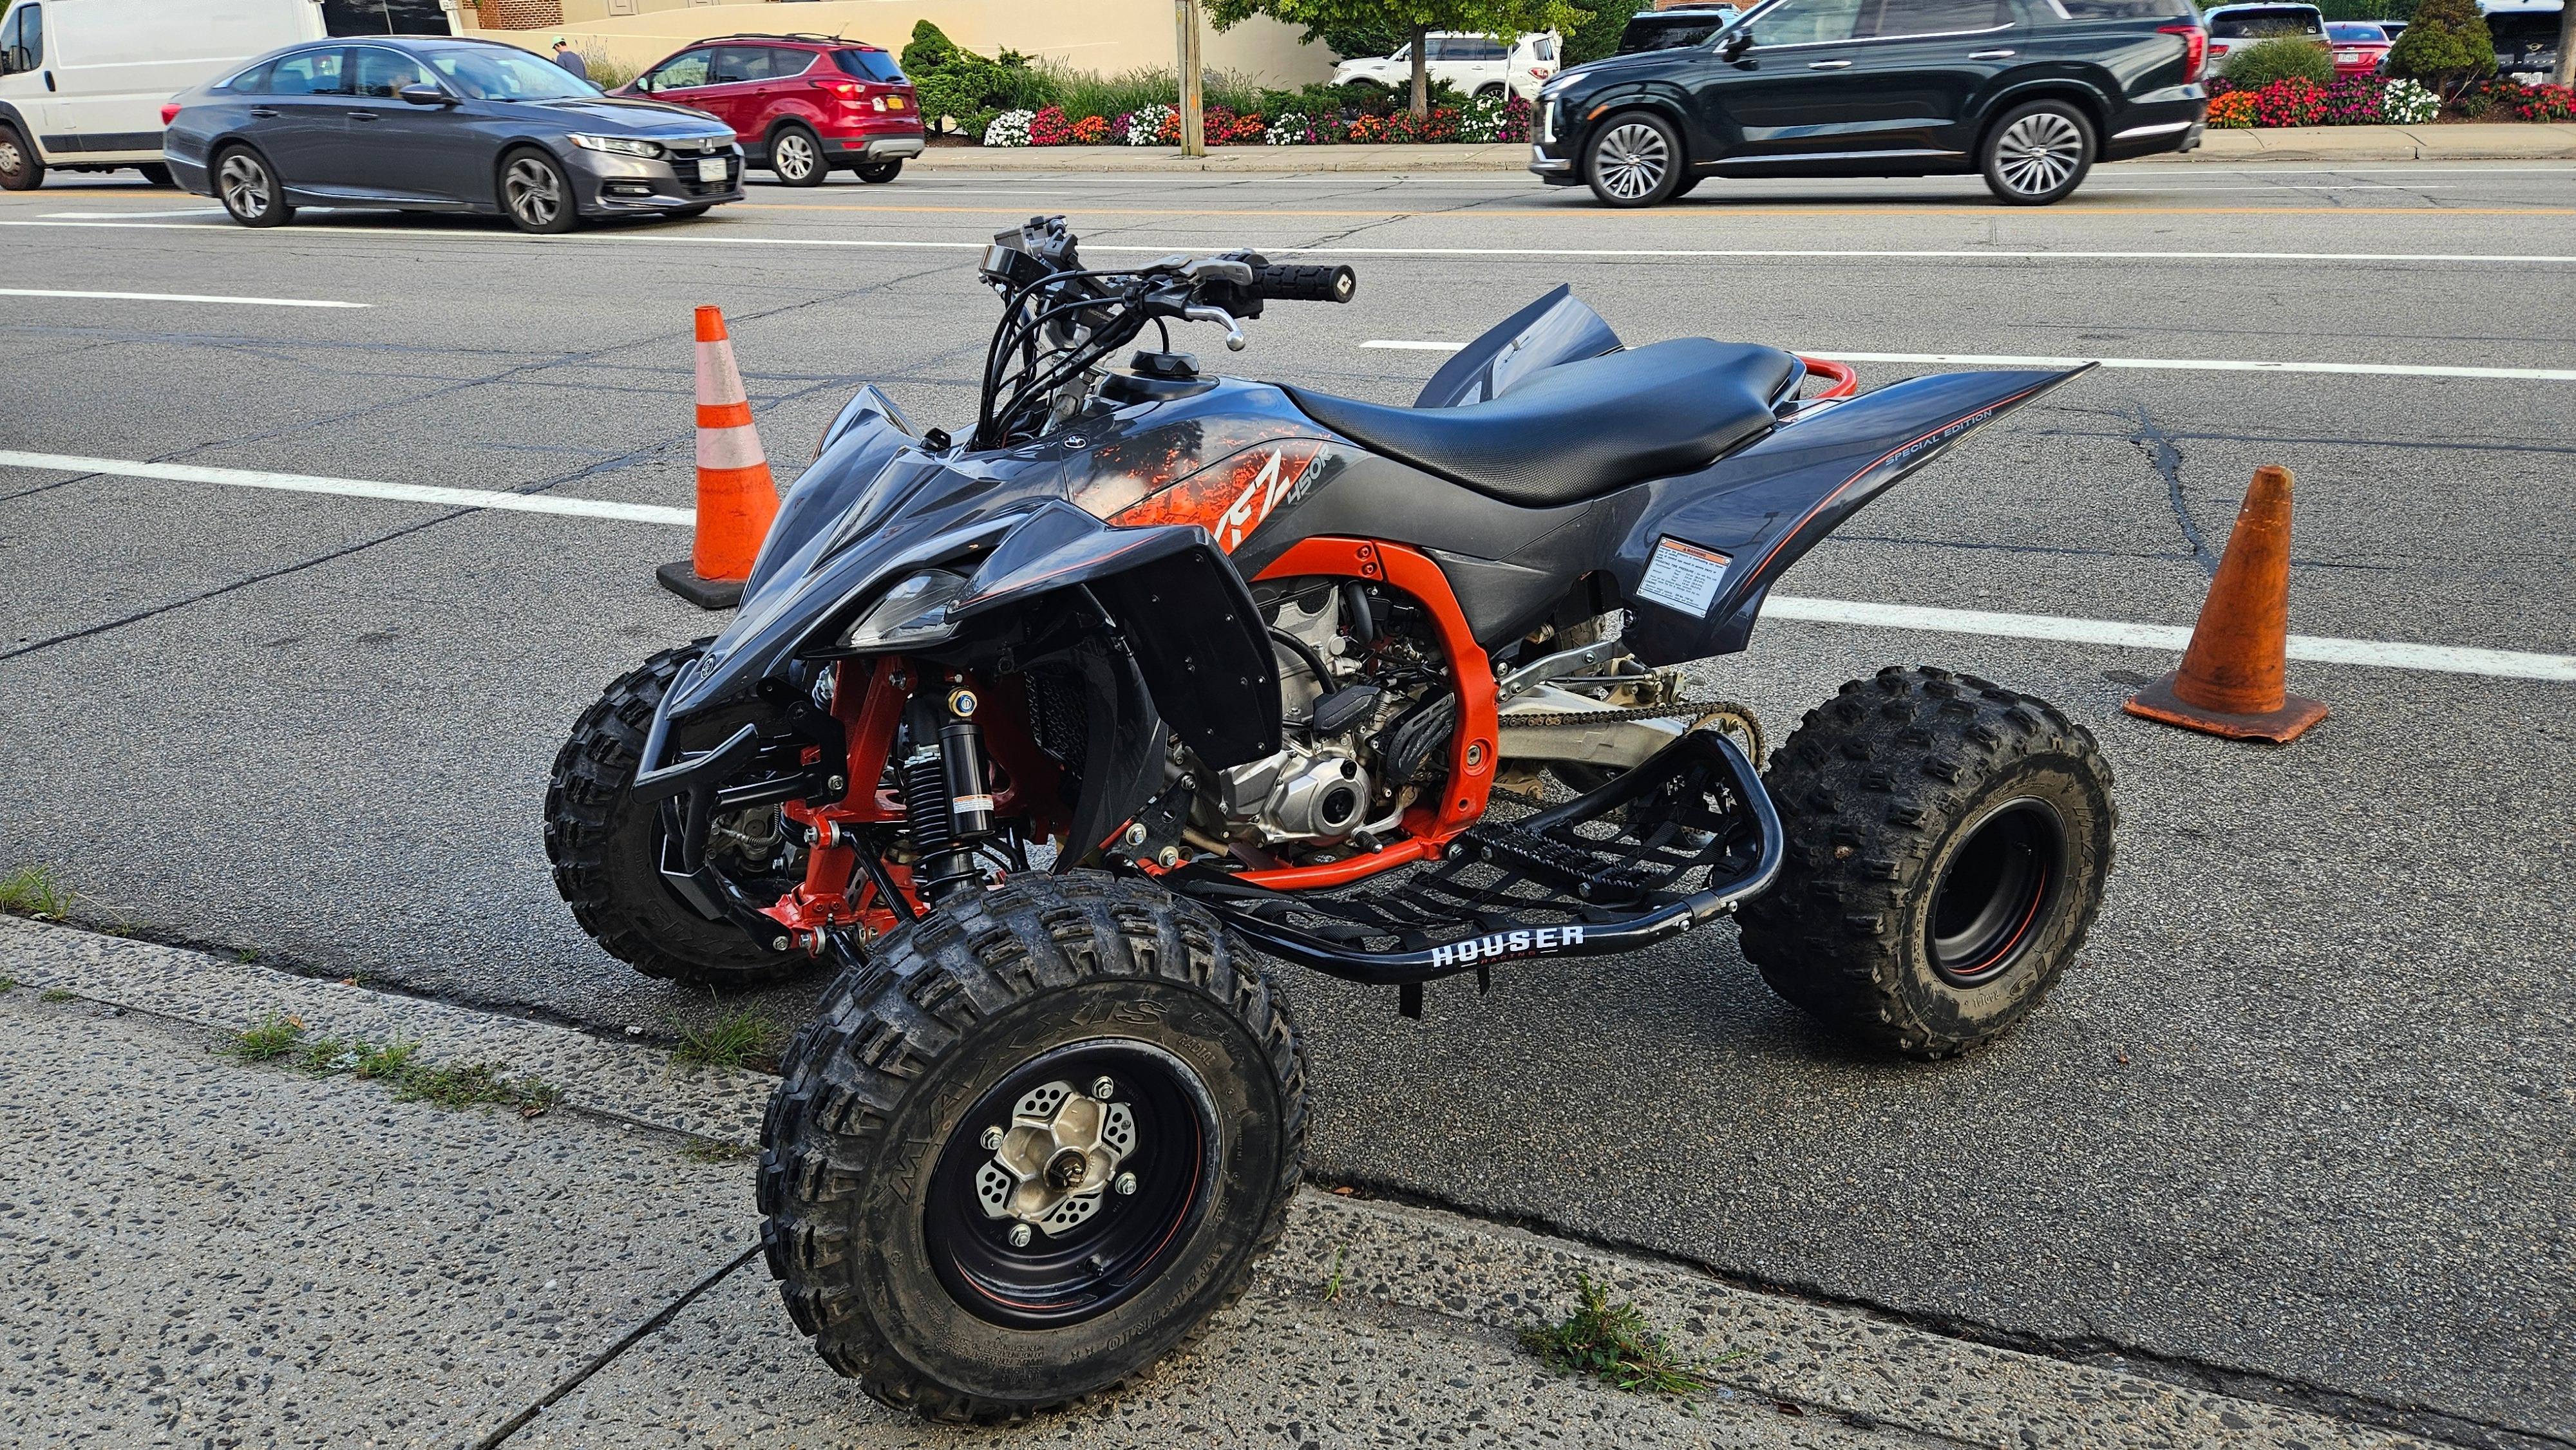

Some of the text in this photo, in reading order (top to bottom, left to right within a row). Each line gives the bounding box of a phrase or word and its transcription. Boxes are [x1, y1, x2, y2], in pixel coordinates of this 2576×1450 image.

[1885, 410, 1992, 466] SPECIAL EDITION
[1287, 443, 1332, 505] 450R
[1686, 548, 1707, 558] WARNING
[2010, 806, 2097, 1002] MAXXIS
[1432, 926, 1585, 968] HOUSER
[1480, 950, 1537, 965] RACING
[1973, 990, 1999, 1008] RADIAL
[1178, 1035, 1216, 1067] RADIAL
[885, 998, 1168, 1203] MAXXIS
